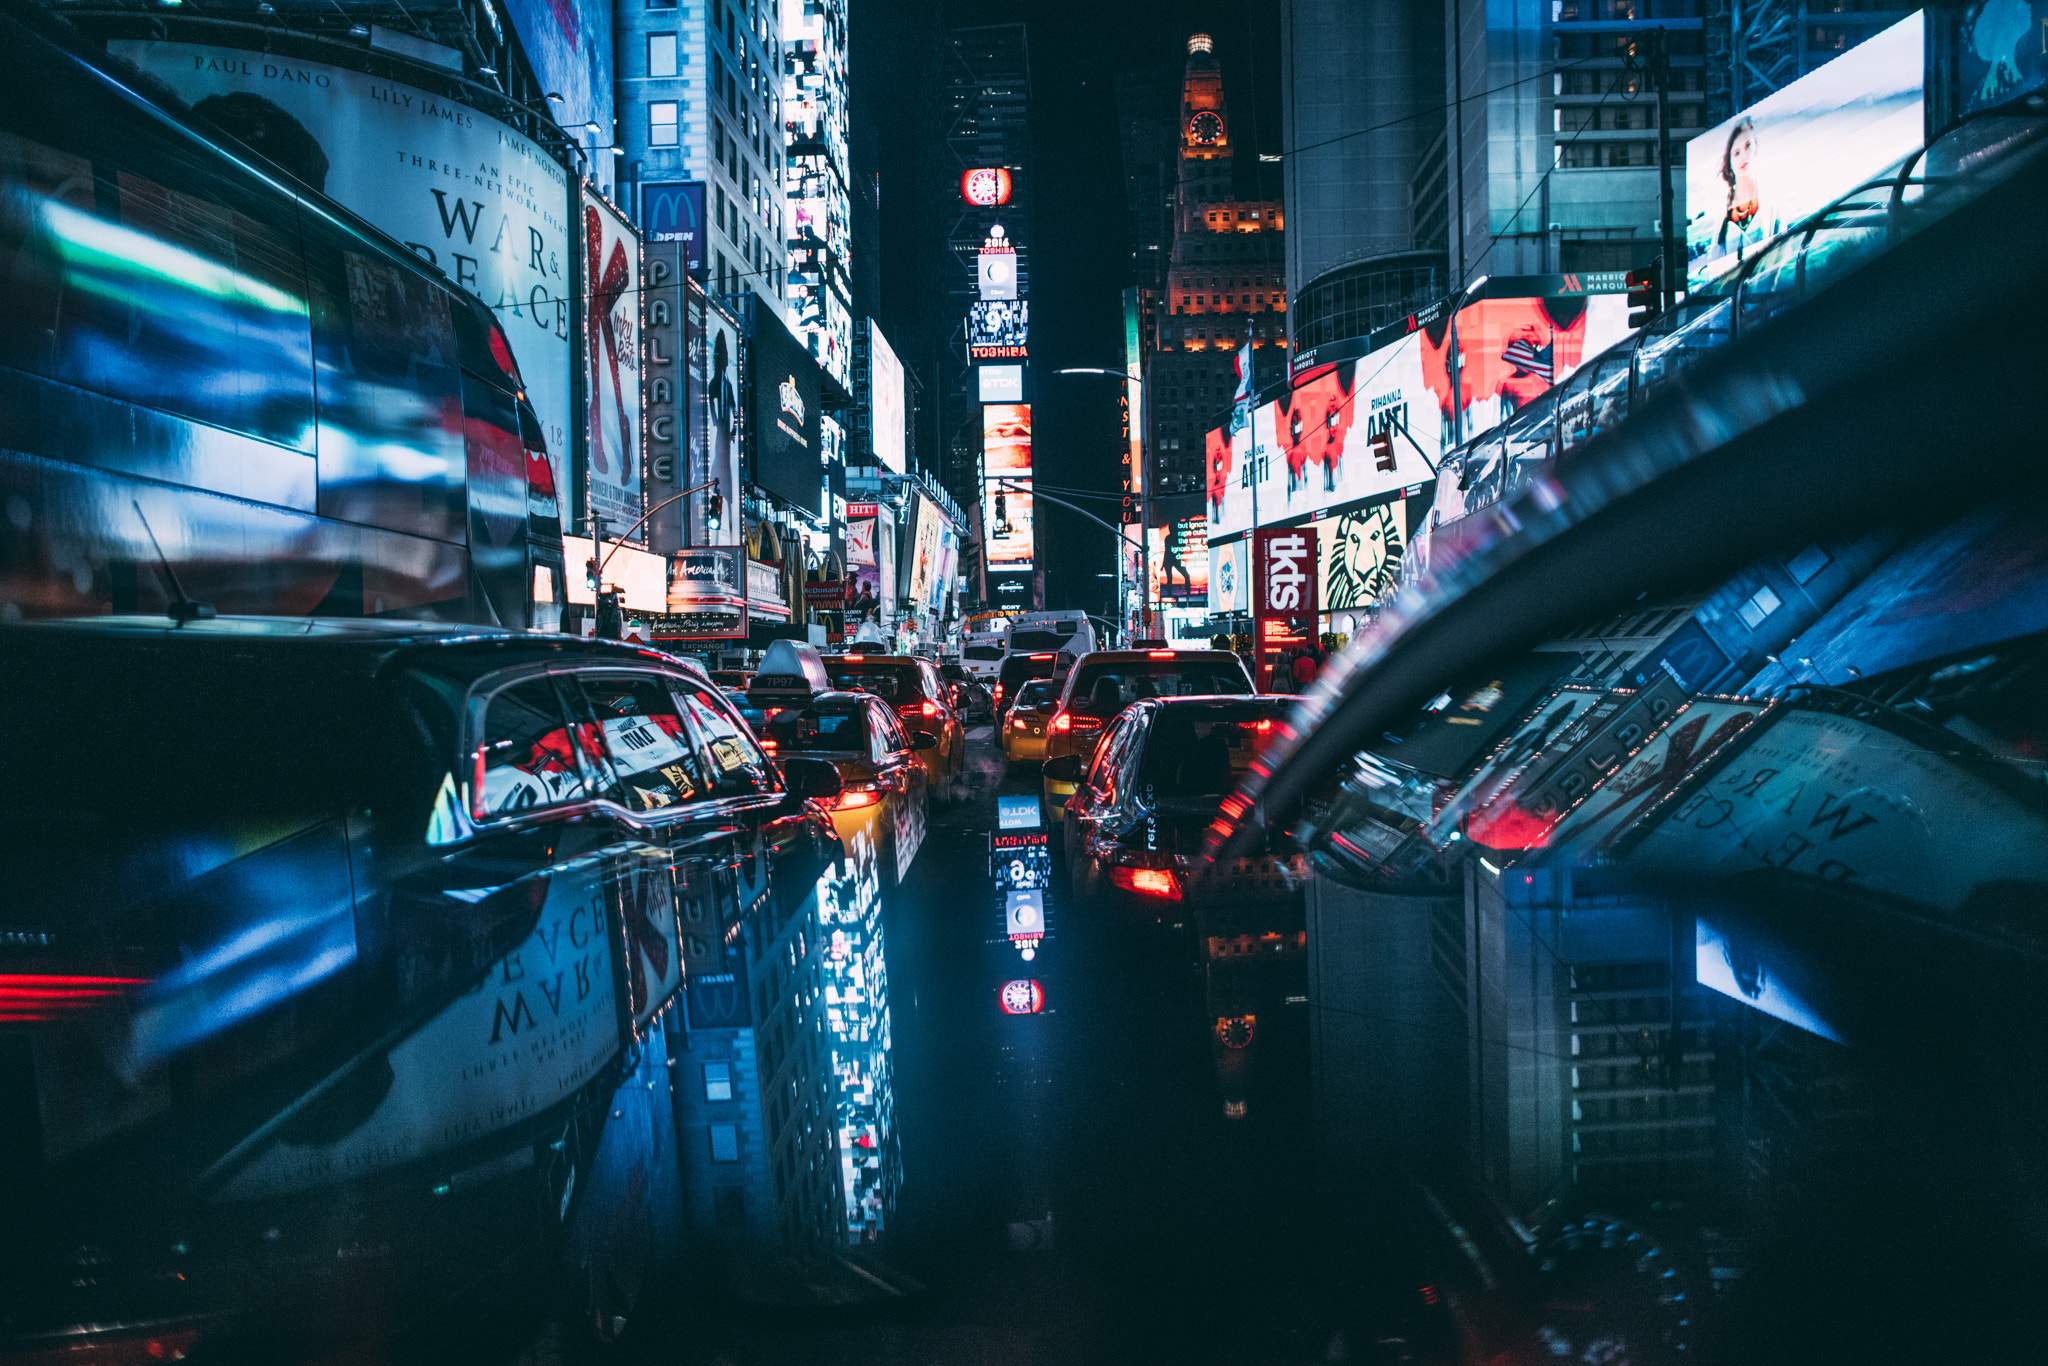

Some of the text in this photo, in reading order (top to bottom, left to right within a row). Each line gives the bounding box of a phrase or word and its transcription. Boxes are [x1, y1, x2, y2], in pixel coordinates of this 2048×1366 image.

[194, 55, 331, 88] PAUL DANO
[371, 85, 473, 129] LILY JAMES
[498, 130, 567, 189] JAMES NORTON
[479, 162, 535, 199] AN EPIC
[430, 187, 547, 279] WAR
[543, 211, 568, 239] EVENT
[978, 246, 1016, 254] TOSHIBA
[984, 237, 1010, 248] 2016
[1587, 273, 1626, 282] MARRIO
[1587, 282, 1632, 291] MARQUI
[1417, 301, 1442, 318] MARRIOTT
[1417, 311, 1440, 327] MARQUIS
[970, 346, 1029, 358] TOSHIBA
[1293, 348, 1317, 364] MARRIOTT
[649, 258, 675, 482] PALACE
[1293, 358, 1315, 371] MARQUIS
[991, 378, 1019, 388] TDK
[1371, 388, 1402, 411] RIHANNA
[1366, 401, 1409, 447] ANTI
[550, 424, 563, 447] 18
[849, 505, 876, 515] HIT!
[1269, 533, 1308, 611] tkts
[681, 642, 727, 651] EXCHANGE
[766, 677, 794, 687] 7P97
